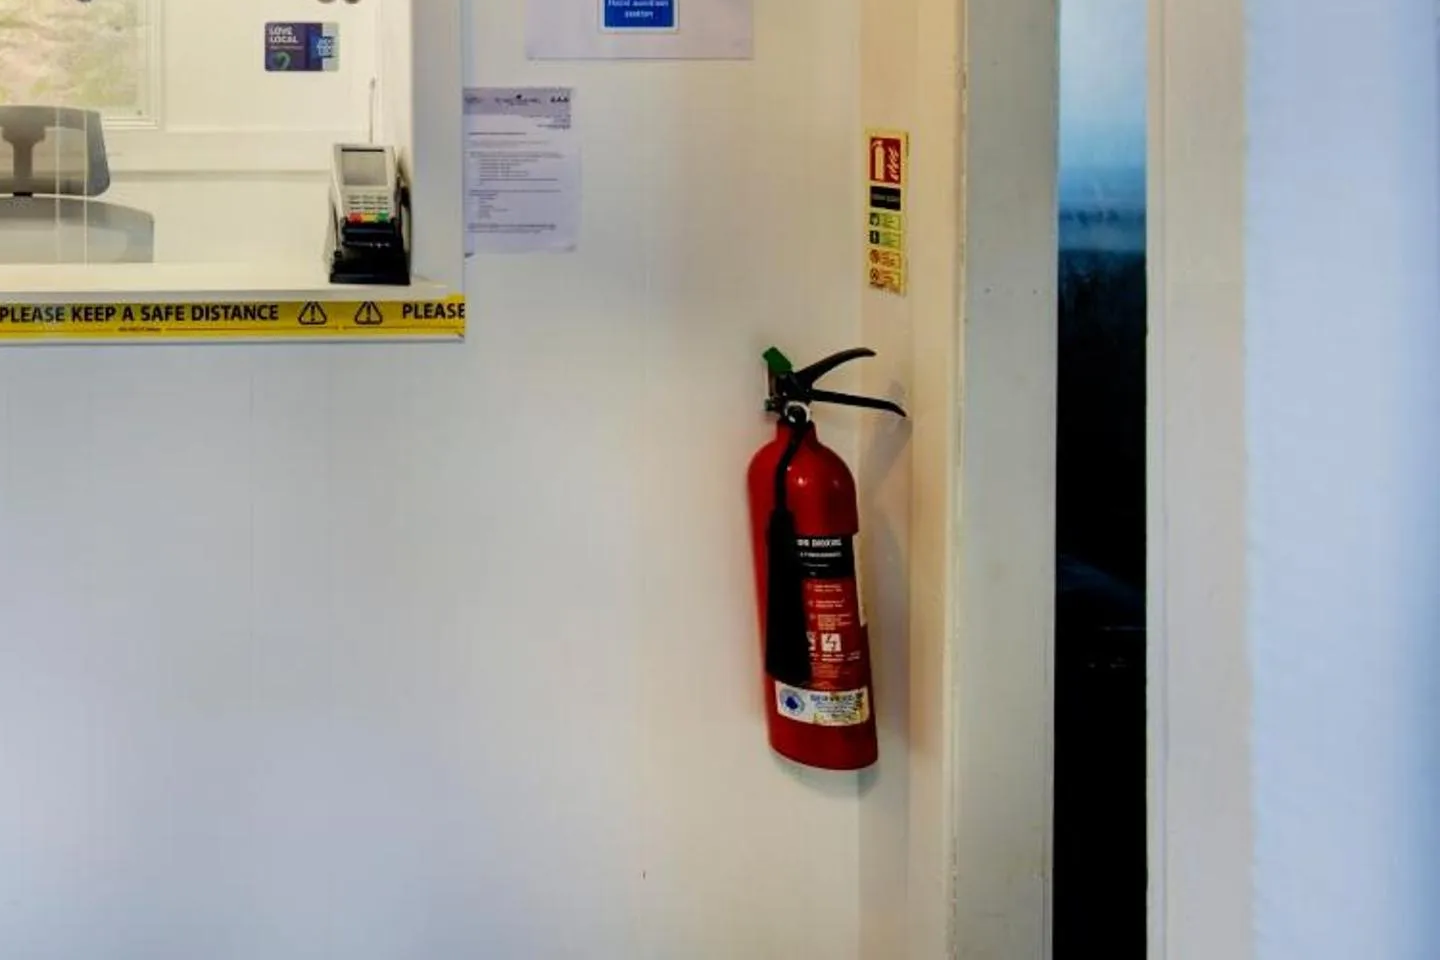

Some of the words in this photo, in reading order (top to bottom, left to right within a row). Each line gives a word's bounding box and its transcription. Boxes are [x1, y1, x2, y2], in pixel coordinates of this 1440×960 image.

[70, 305, 116, 323] KEEP
[121, 305, 135, 322] A
[140, 303, 185, 322] SAFE
[191, 303, 280, 322] DISTANCE
[402, 302, 466, 319] PLEASE
